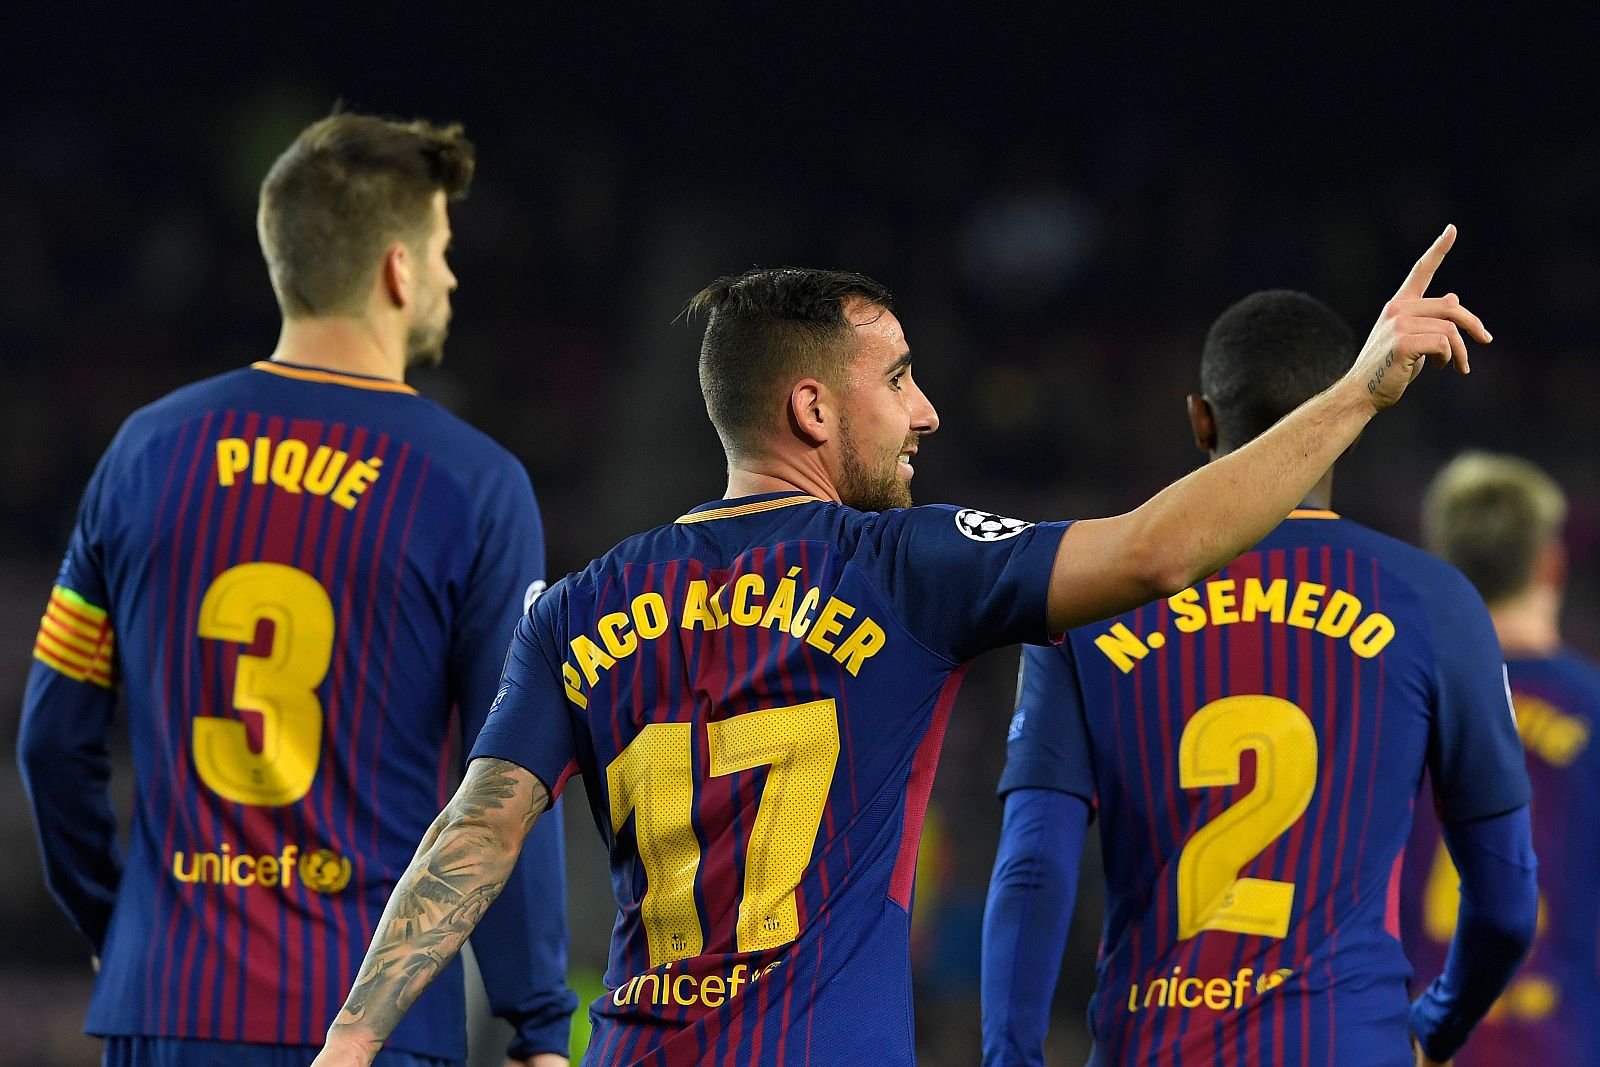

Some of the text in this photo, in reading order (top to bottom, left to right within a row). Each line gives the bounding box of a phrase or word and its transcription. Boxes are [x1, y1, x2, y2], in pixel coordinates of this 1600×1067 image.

[216, 437, 384, 510] PIQUÉ
[192, 561, 336, 807] 3
[562, 565, 886, 710] PACO ALCÁCER
[1094, 578, 1395, 674] N. SEMEDO
[173, 842, 298, 888] unicef
[606, 698, 840, 968] 17
[1177, 694, 1319, 941] 2
[613, 962, 748, 1008] unicef
